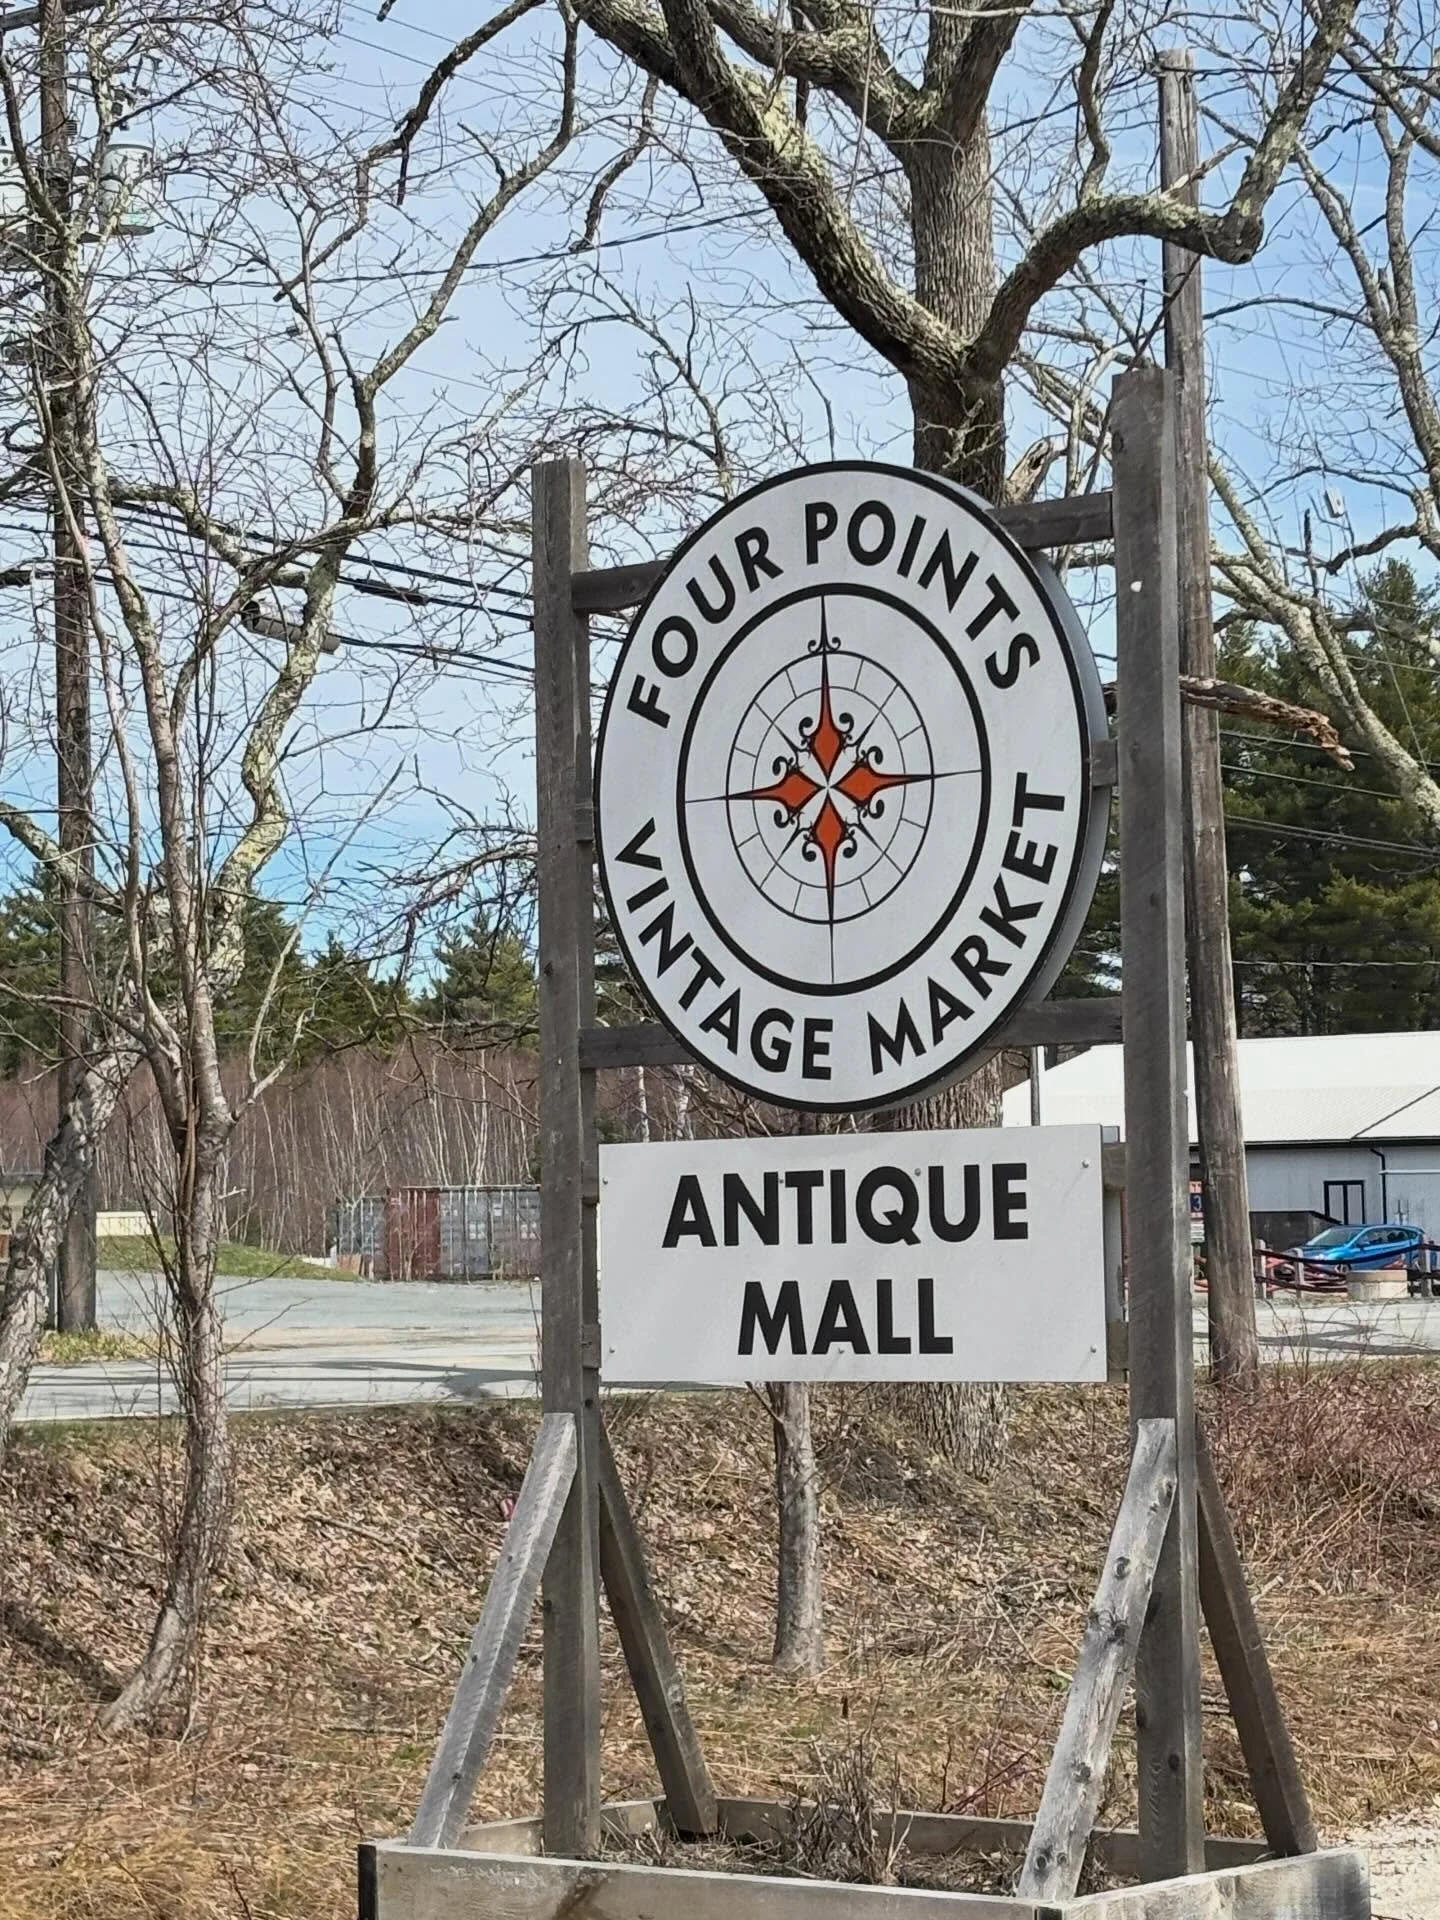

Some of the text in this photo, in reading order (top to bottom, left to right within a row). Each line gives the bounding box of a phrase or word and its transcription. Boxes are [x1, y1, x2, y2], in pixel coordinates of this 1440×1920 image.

[626, 500, 1041, 729] FOUR POINTS
[614, 771, 1066, 1081] VINTAGE MARKET
[661, 1162, 1029, 1249] ANTIQUE
[737, 1278, 954, 1356] MALL
